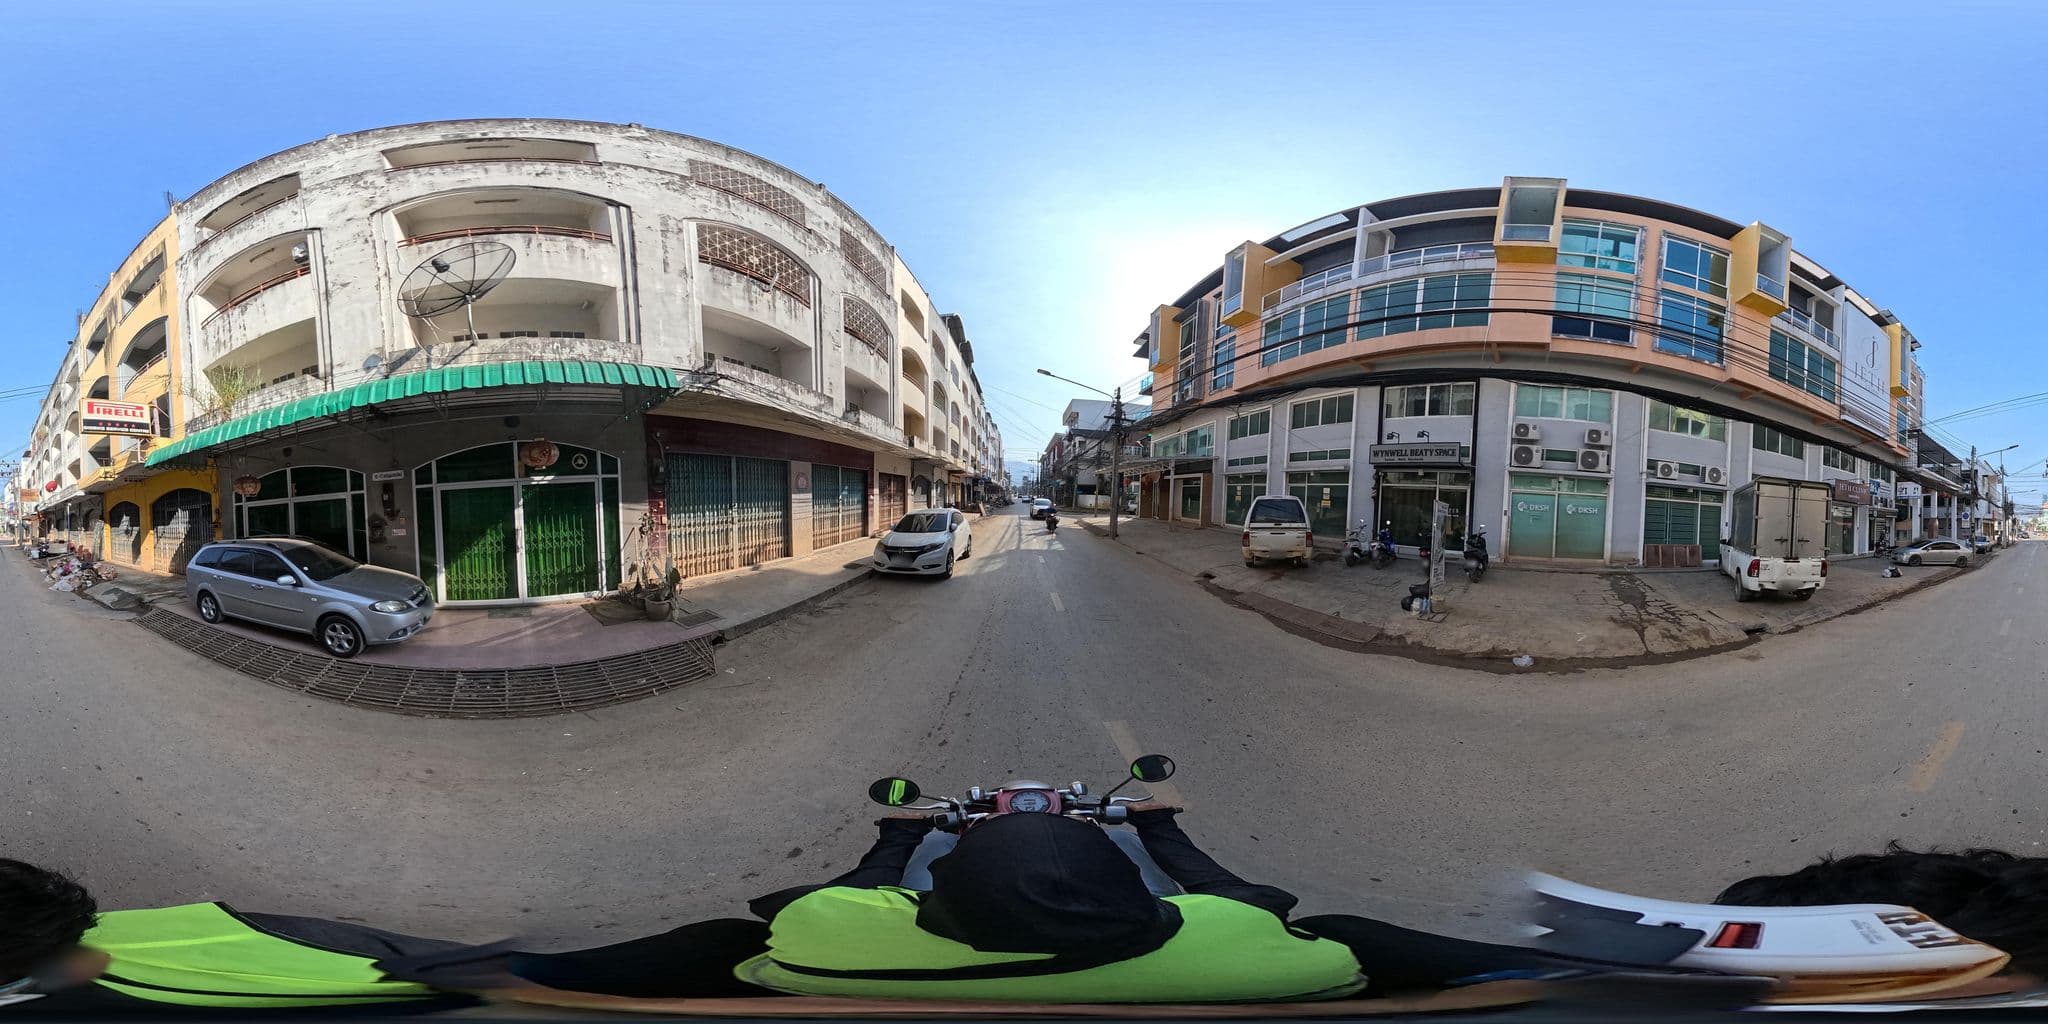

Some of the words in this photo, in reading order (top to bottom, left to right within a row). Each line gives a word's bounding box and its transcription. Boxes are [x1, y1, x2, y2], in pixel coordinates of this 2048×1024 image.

[87, 401, 145, 418] PIRELLI
[1373, 449, 1409, 457] WYNWELL
[1434, 448, 1457, 457] SPACE
[1529, 504, 1550, 512] DKSH
[1578, 506, 1598, 514] DKSH
